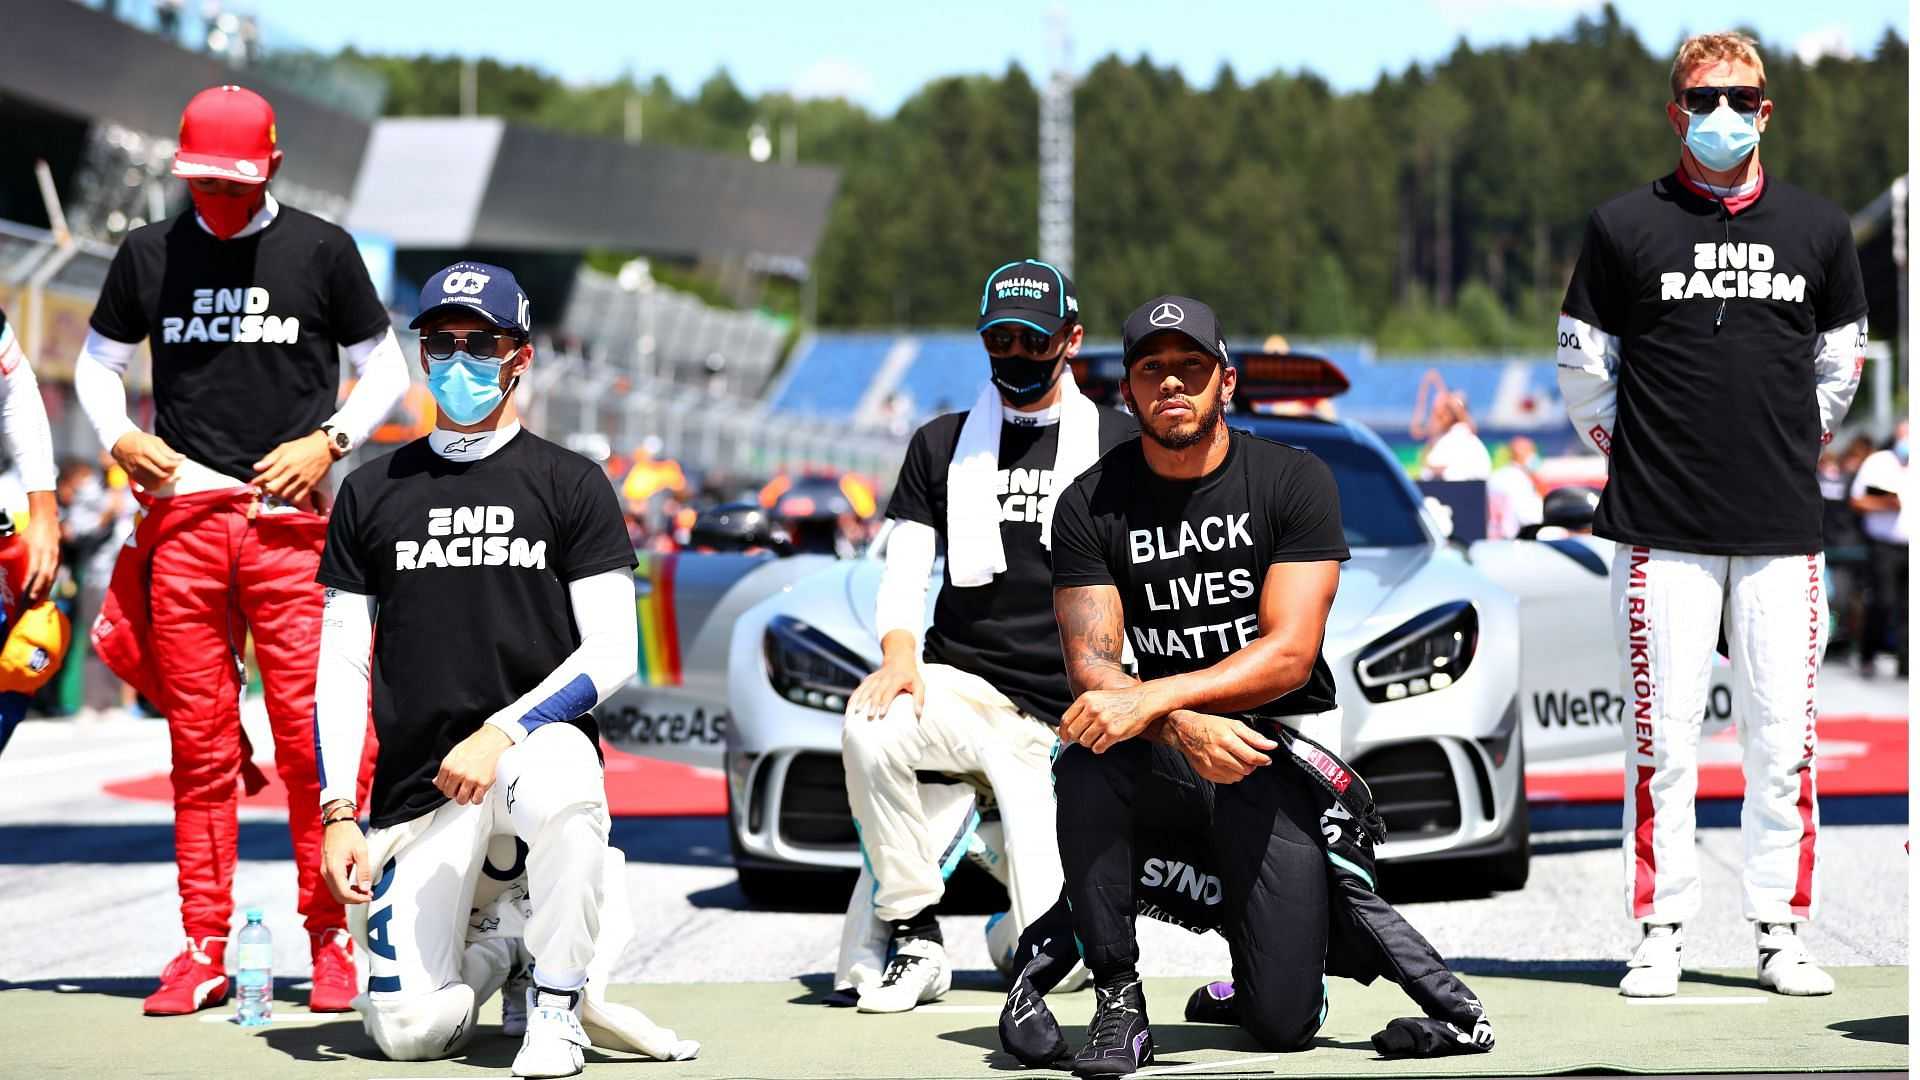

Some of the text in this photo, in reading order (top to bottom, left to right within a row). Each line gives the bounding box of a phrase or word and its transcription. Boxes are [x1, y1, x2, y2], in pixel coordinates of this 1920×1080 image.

[1694, 242, 1775, 271] END
[192, 286, 270, 315] END
[995, 277, 1050, 293] WILLIAMS
[997, 287, 1042, 300] RACING
[1660, 270, 1807, 303] RACISM
[162, 315, 300, 345] RACISM
[427, 505, 515, 536] END
[395, 536, 547, 571] RACISM
[1129, 512, 1254, 565] BLACK
[1144, 568, 1255, 612] LIVES
[1132, 613, 1260, 659] MATTE
[1628, 545, 1657, 758] IMI RÄIKKÖNEN
